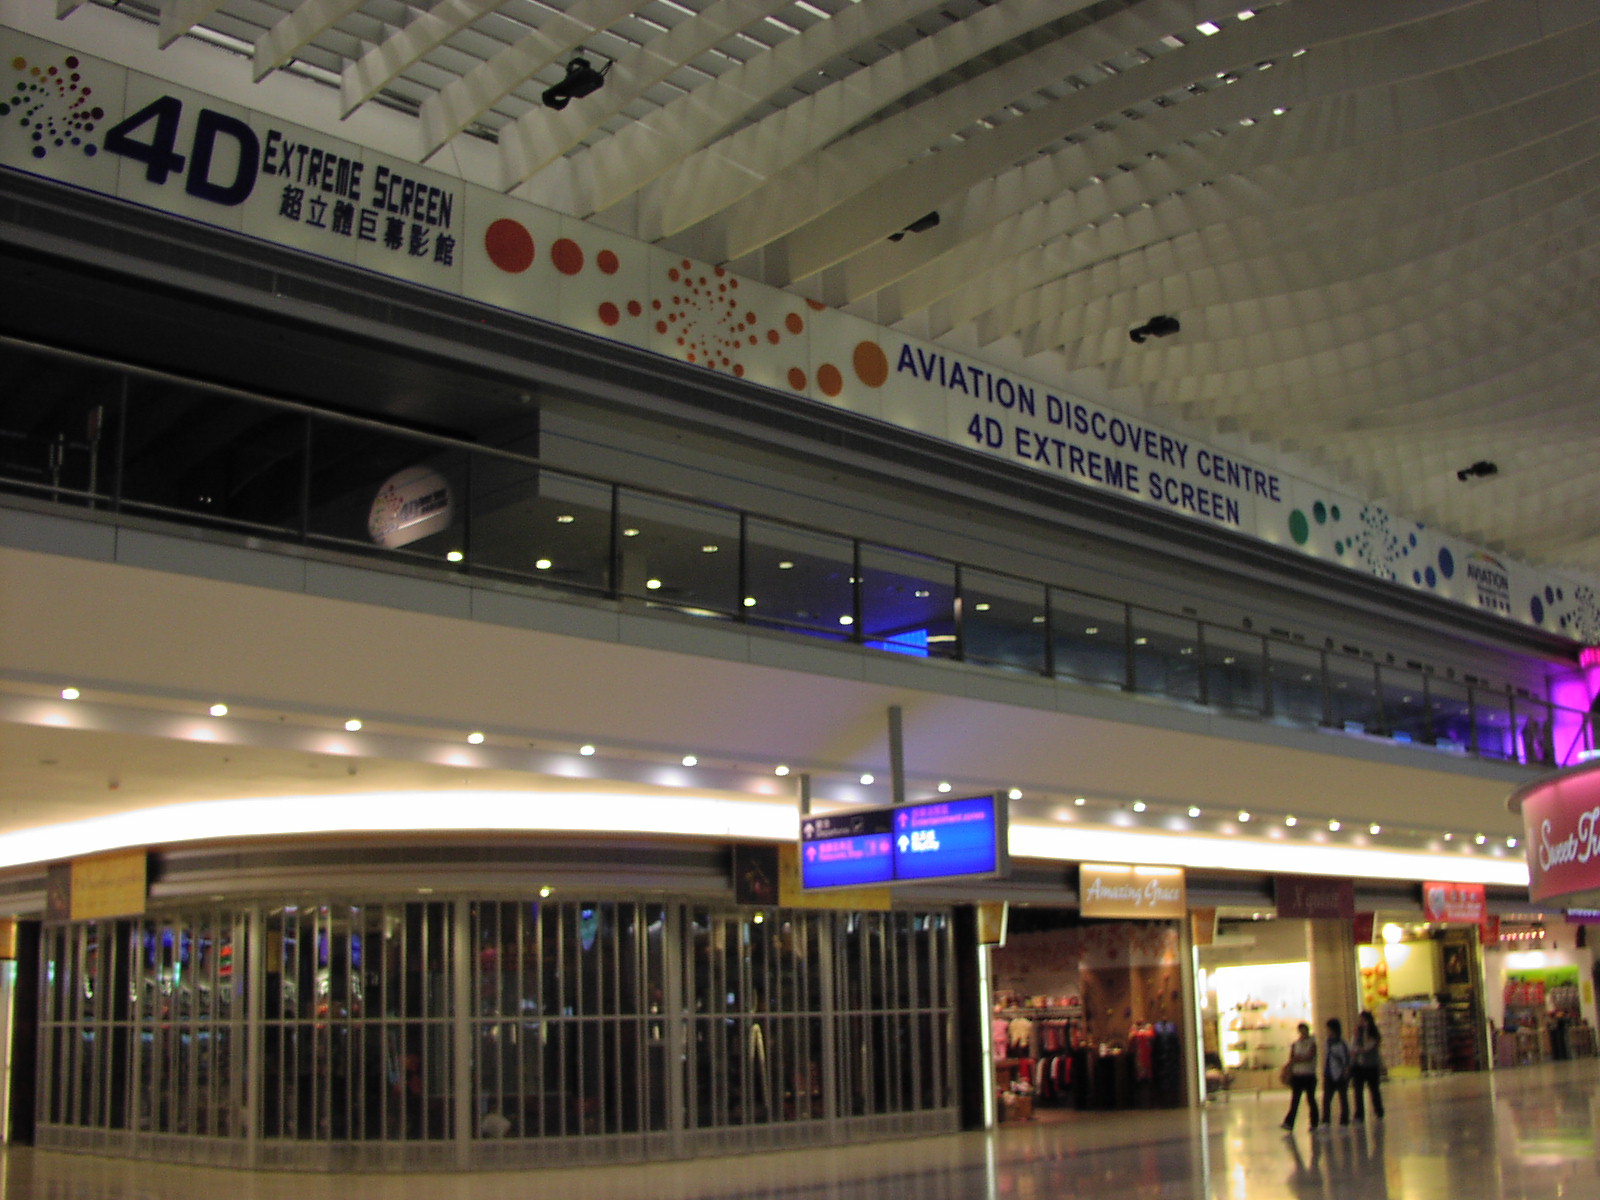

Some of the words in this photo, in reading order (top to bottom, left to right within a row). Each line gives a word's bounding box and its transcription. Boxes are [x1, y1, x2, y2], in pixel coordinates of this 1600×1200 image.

[103, 95, 260, 206] 4D
[262, 130, 364, 201] EXTREME
[373, 166, 454, 229] SCREEN
[279, 184, 456, 267] 超立體巨幕影館
[898, 343, 1035, 417] AVIATION
[1046, 394, 1189, 468] DISCOVERY
[1196, 449, 1282, 502] CENTRE
[967, 413, 1003, 449] 4D
[1014, 427, 1140, 494] EXTREME
[1149, 472, 1240, 526] SCREEN
[1086, 877, 1143, 907] Amazing
[1143, 878, 1180, 908] Grace
